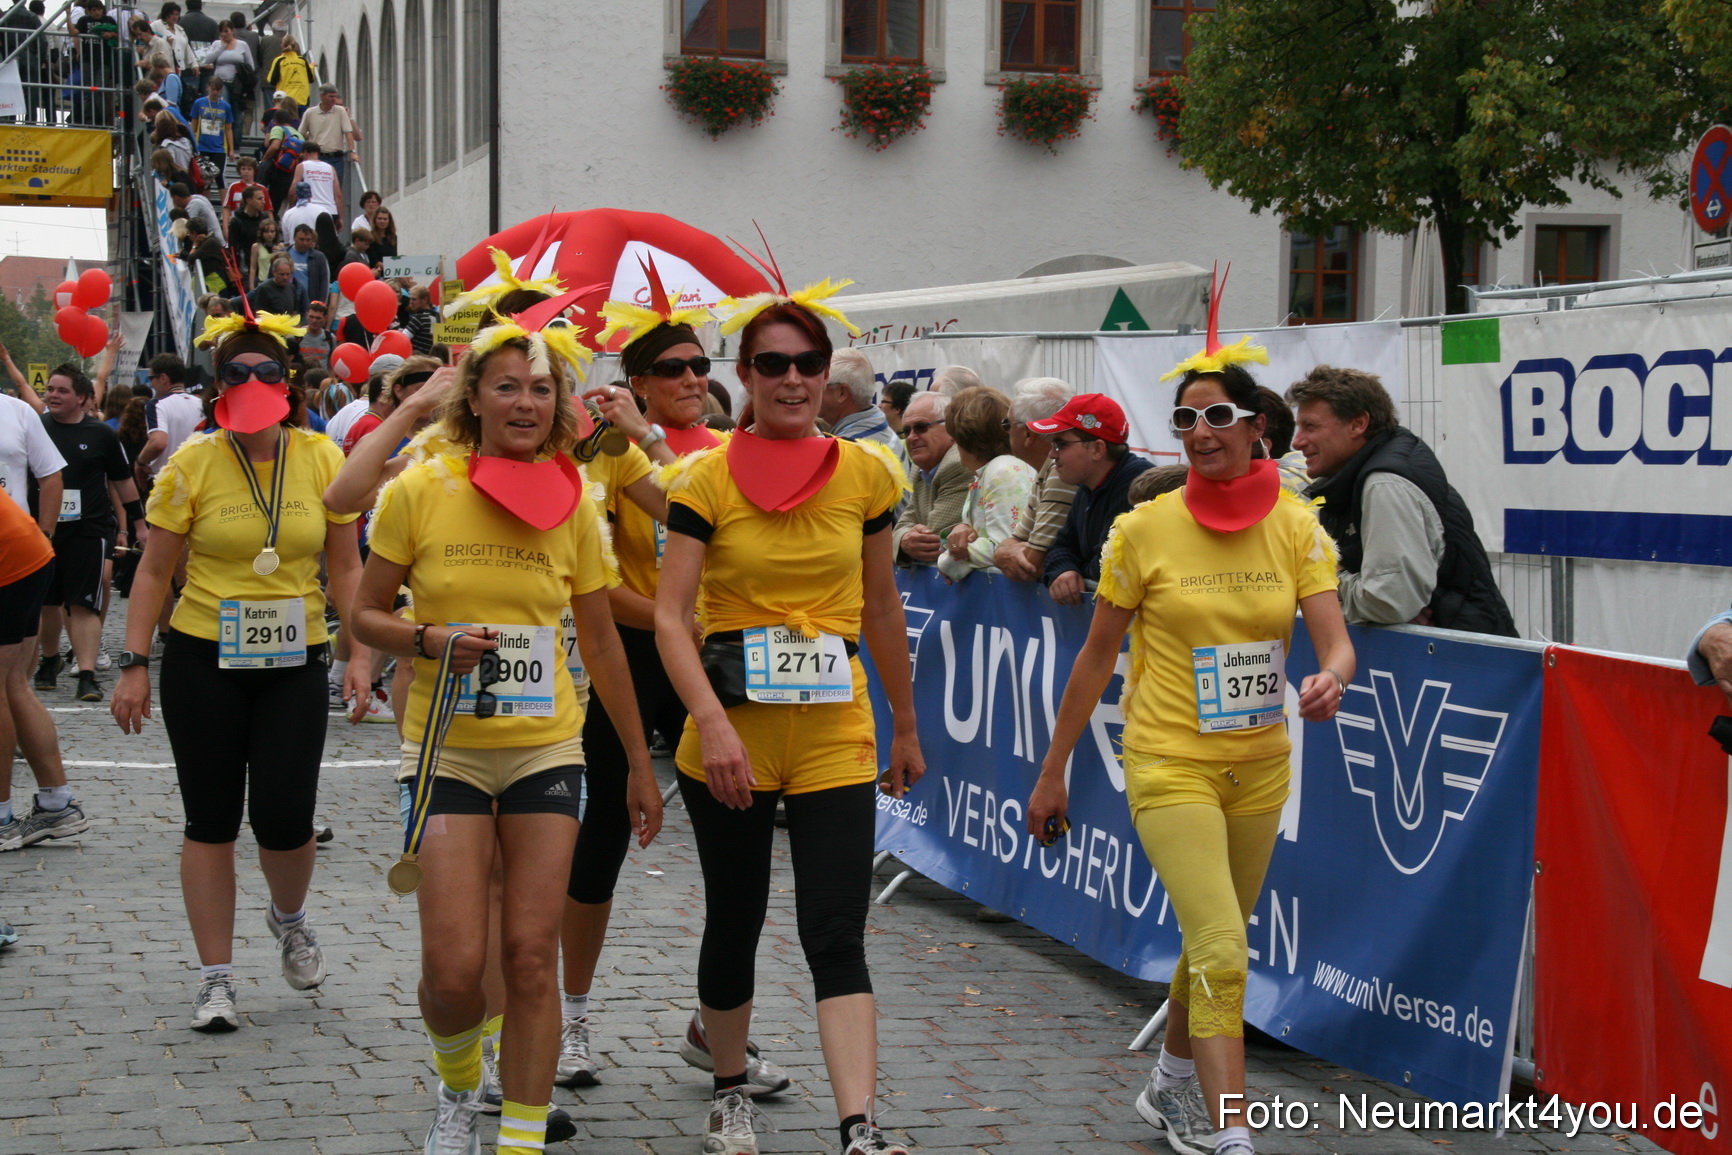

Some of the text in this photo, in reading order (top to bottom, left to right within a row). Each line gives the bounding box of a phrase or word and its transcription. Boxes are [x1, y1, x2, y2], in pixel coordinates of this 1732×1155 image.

[32, 164, 82, 175] Stadtlauf
[449, 309, 483, 321] ypisier
[33, 372, 45, 386] A
[63, 501, 76, 511] 73
[444, 543, 554, 568] BRIGITTEKARL
[1180, 571, 1283, 587] BRIGITTEKARL
[245, 607, 277, 619] Katrin
[225, 625, 232, 635] C
[246, 624, 297, 644] 2910
[752, 652, 759, 662] C
[777, 652, 837, 673] 2717
[1223, 651, 1271, 668] Johanna
[481, 659, 543, 683] 2900
[1202, 678, 1209, 690] D
[1227, 672, 1278, 699] 3752
[811, 690, 850, 698] PFLEIDERER
[514, 702, 552, 711] PFLEIDERER
[1312, 960, 1494, 1048] www.uniVersa.de
